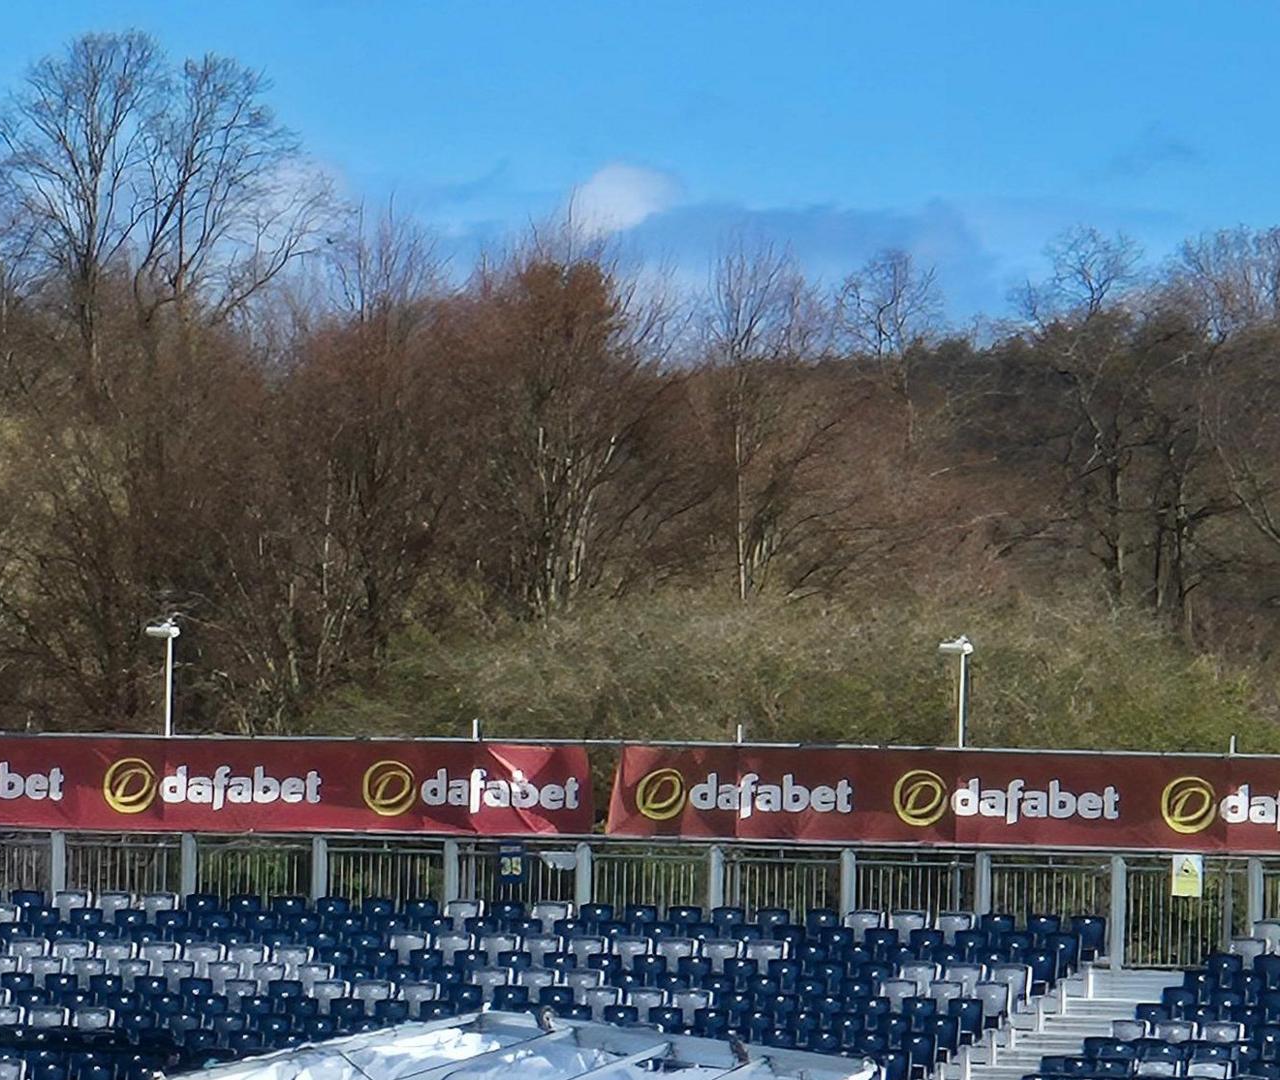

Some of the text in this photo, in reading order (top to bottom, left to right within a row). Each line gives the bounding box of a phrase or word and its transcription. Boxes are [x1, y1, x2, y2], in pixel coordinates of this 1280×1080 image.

[159, 766, 321, 810] dafabet
[689, 773, 852, 819] dafabet
[951, 778, 1119, 824] dafabet
[1219, 784, 1280, 830] da
